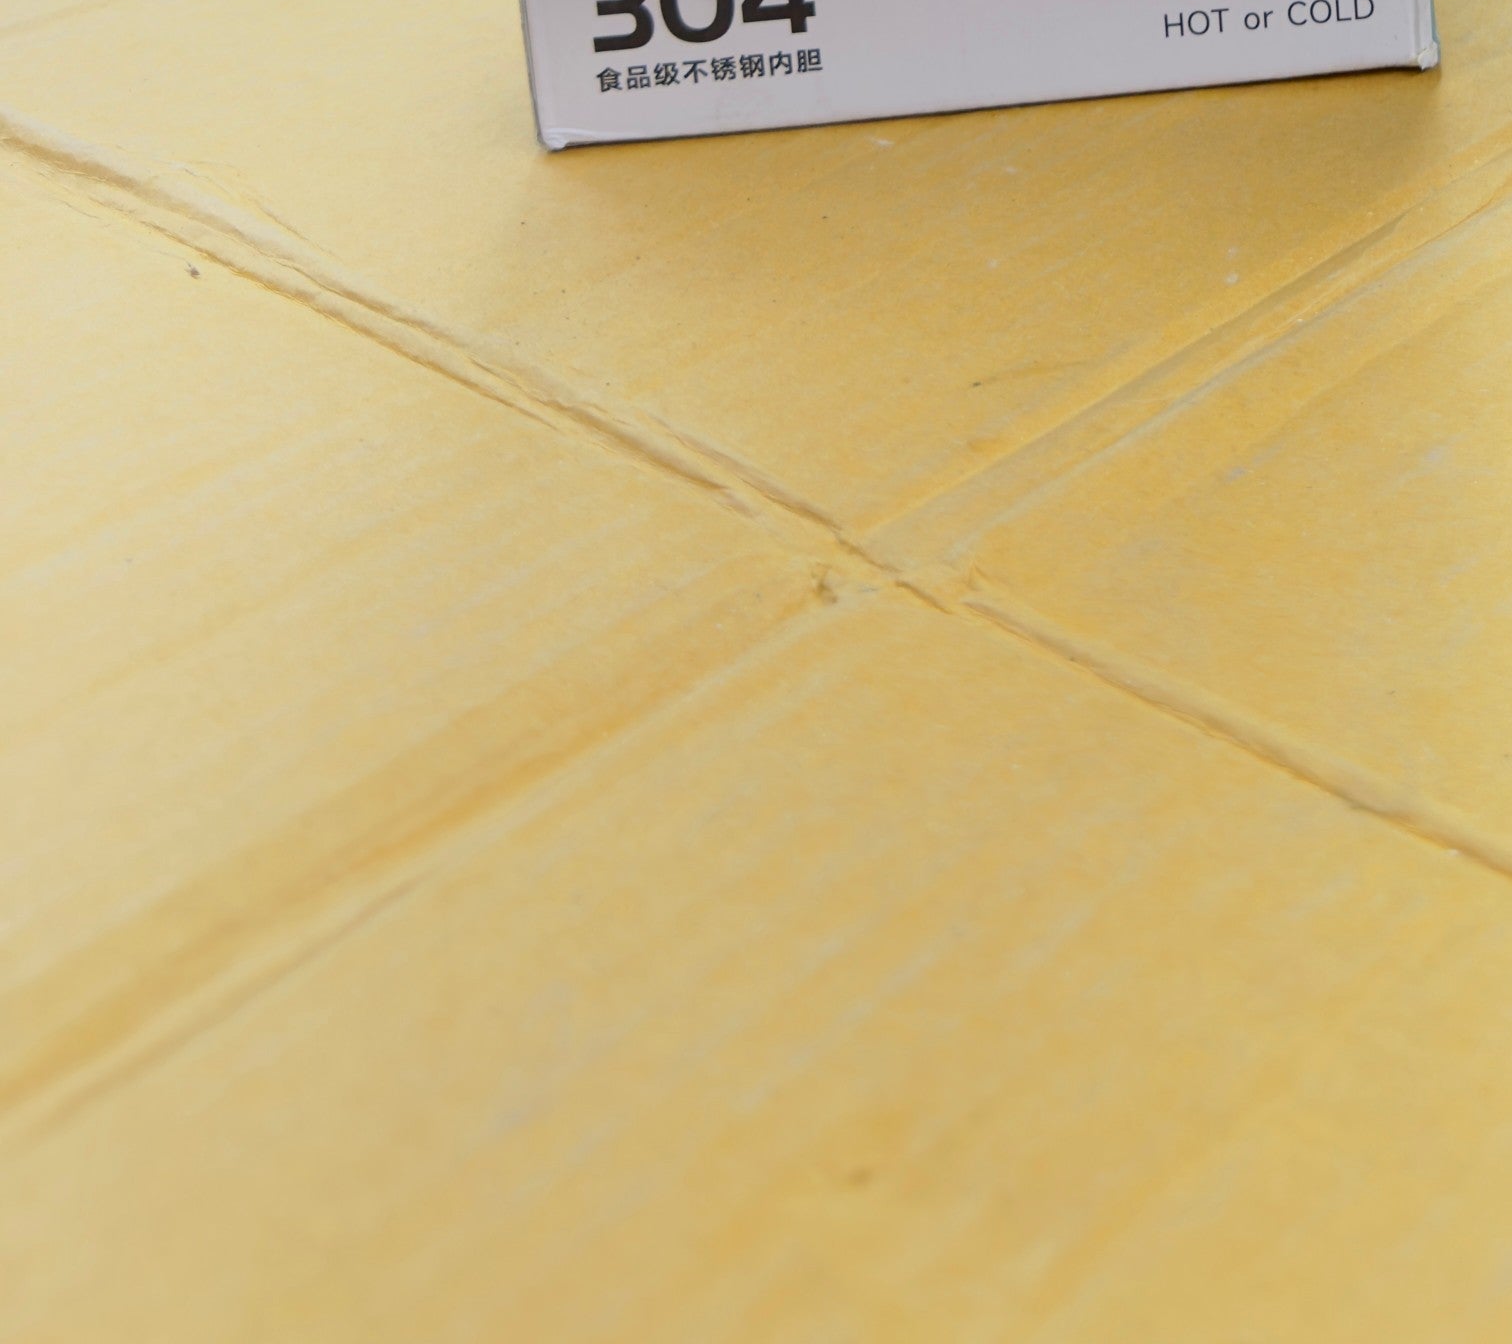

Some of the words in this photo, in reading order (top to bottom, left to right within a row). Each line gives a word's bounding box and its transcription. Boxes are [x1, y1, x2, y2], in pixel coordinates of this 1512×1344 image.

[1164, 7, 1230, 38] HOT
[1244, 10, 1274, 30] or
[596, 48, 823, 92] 食品级不锈钢内胆
